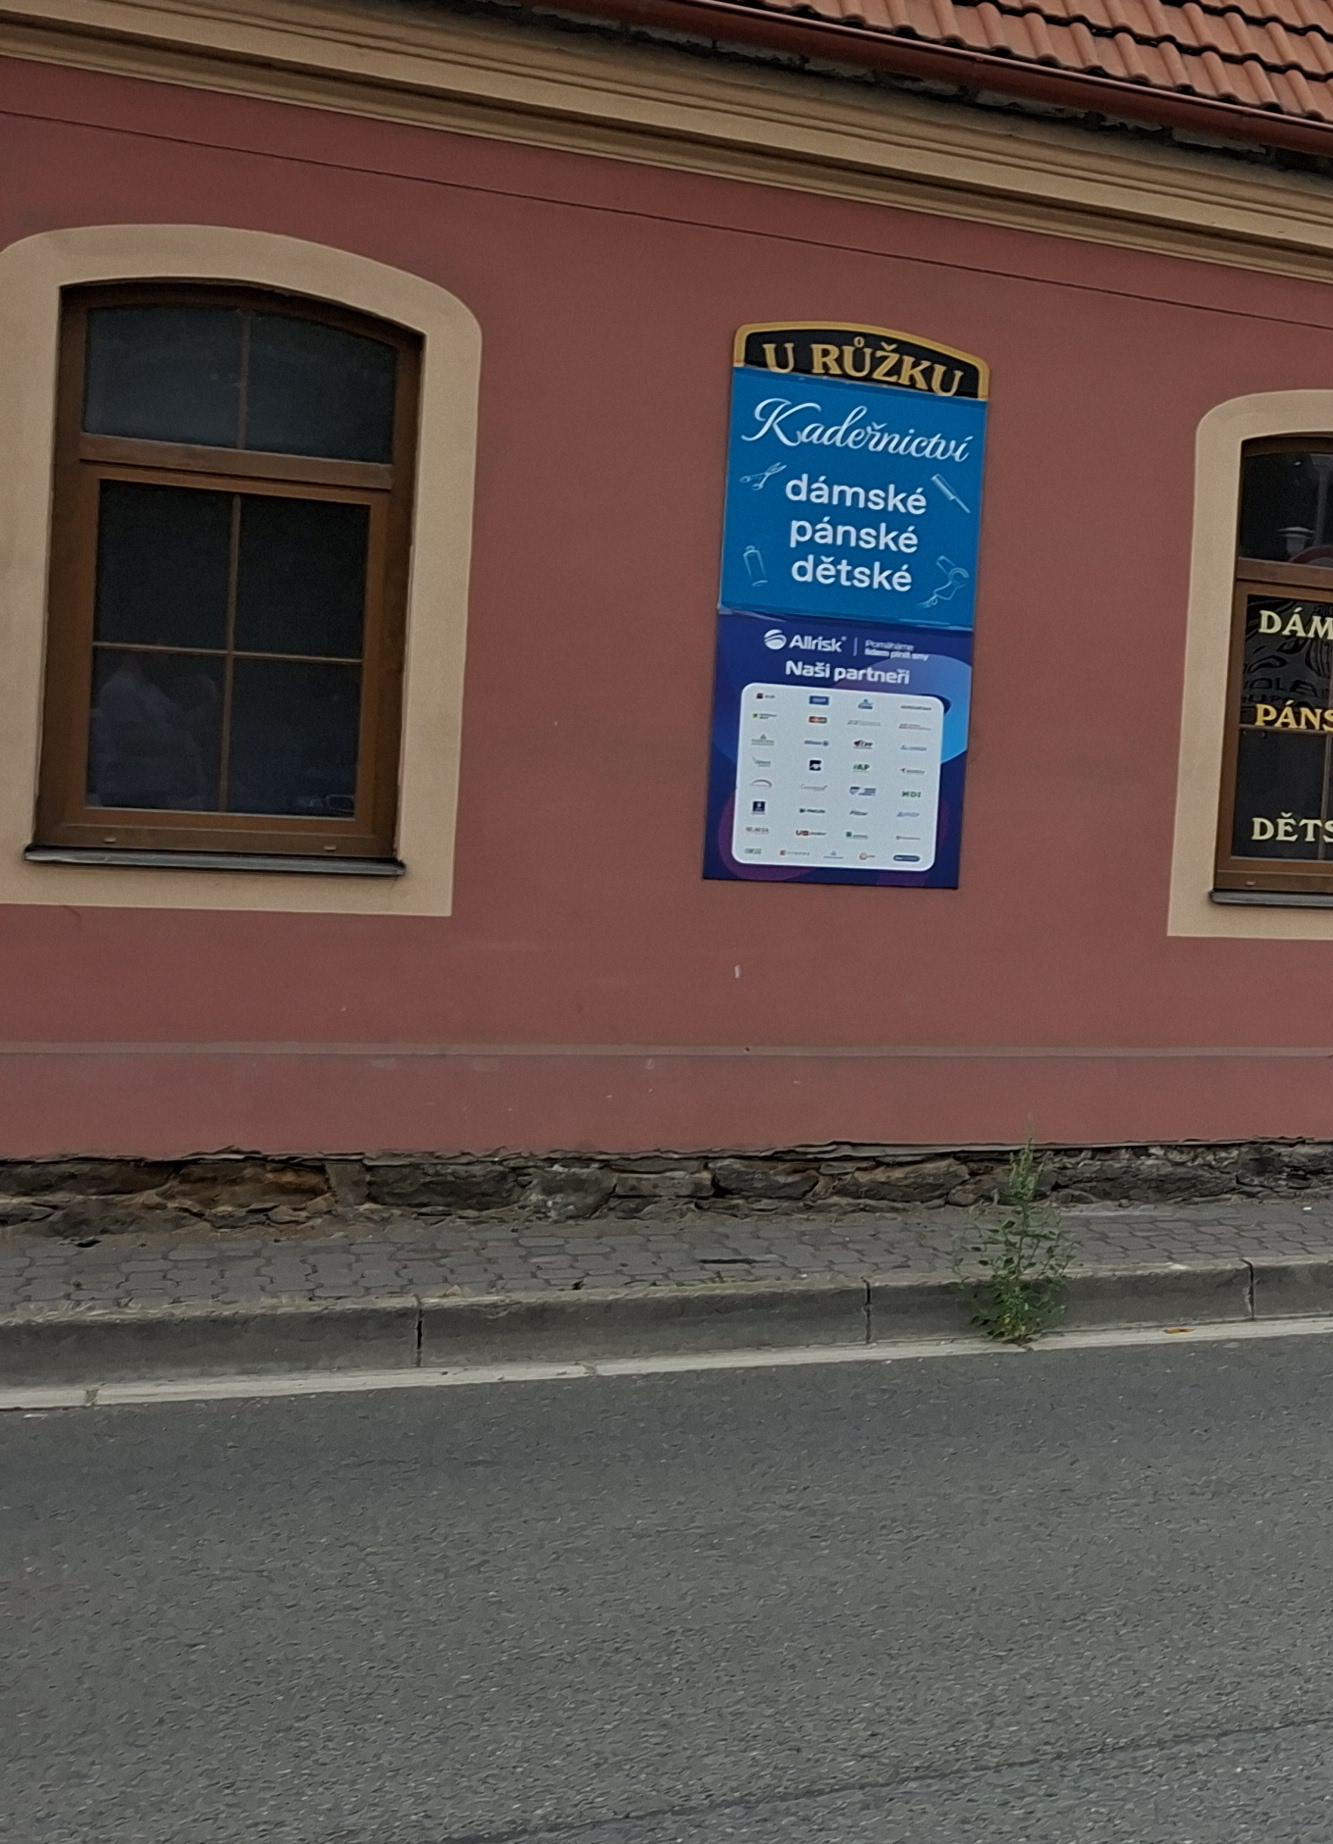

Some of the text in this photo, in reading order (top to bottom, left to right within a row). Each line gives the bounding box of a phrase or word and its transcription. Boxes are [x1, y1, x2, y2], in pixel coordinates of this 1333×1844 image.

[763, 337, 965, 397] U RŮŽKU
[741, 398, 973, 462] Kadeřnictví
[785, 474, 927, 515] dámské
[790, 516, 919, 553] pánské
[791, 554, 913, 592] dětské
[789, 634, 843, 653] Allrisk
[786, 660, 910, 685] Naši partneři
